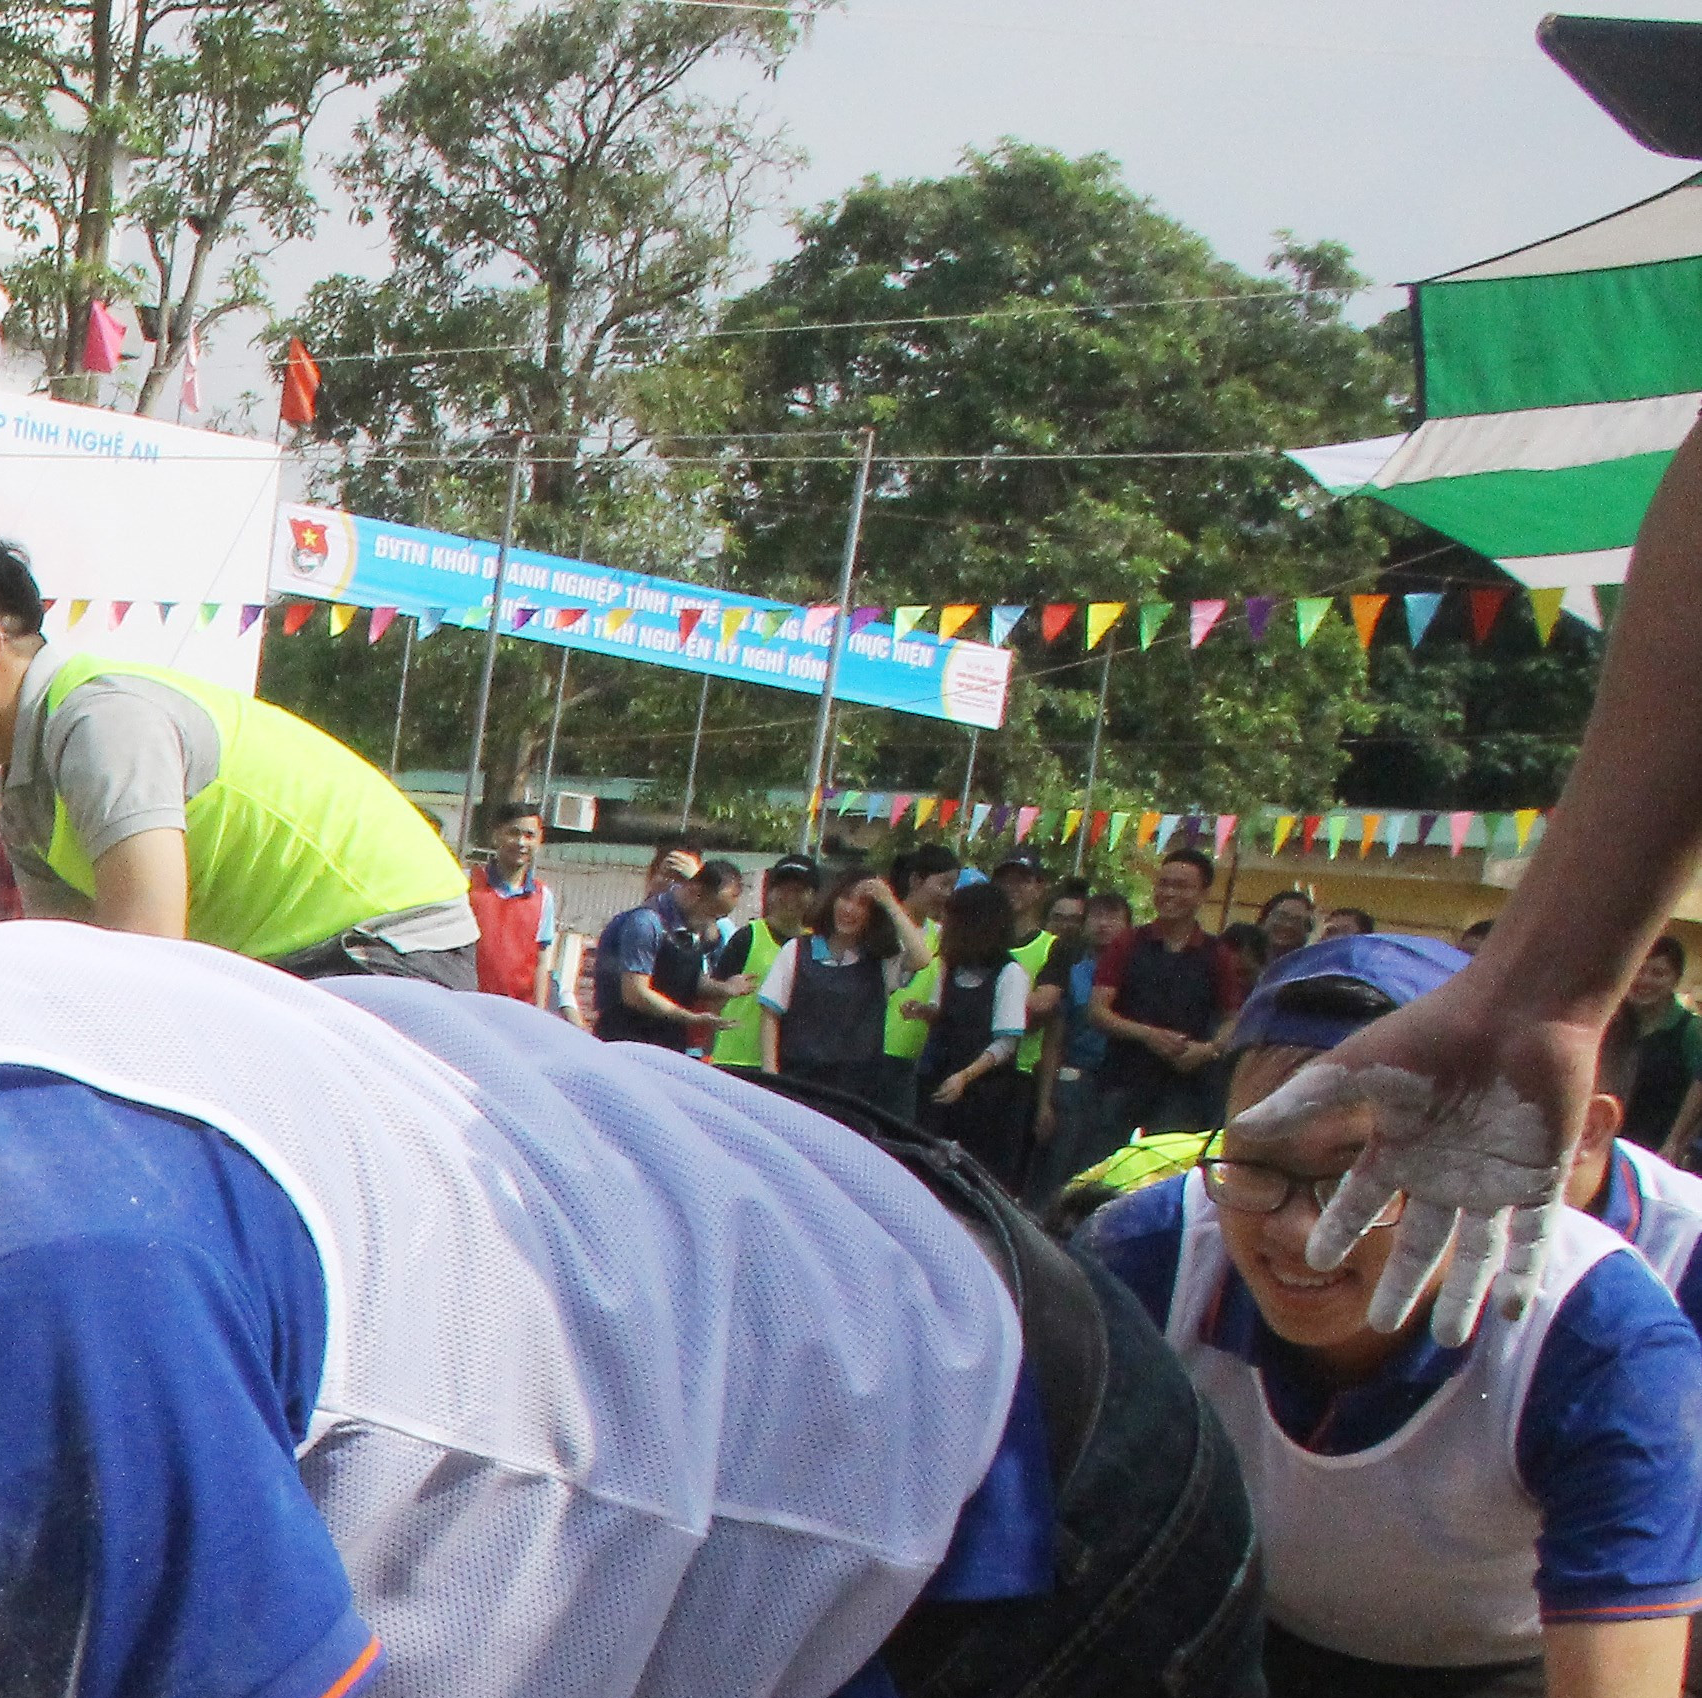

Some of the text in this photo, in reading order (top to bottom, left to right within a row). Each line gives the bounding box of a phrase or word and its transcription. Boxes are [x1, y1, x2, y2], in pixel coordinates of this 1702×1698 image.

[66, 427, 124, 464] NGHỆ
[130, 440, 159, 463] AN
[374, 535, 427, 565] ĐVTN
[431, 545, 479, 576] KHỐI
[481, 556, 550, 591] DANH
[551, 571, 623, 607] NGHIỆP
